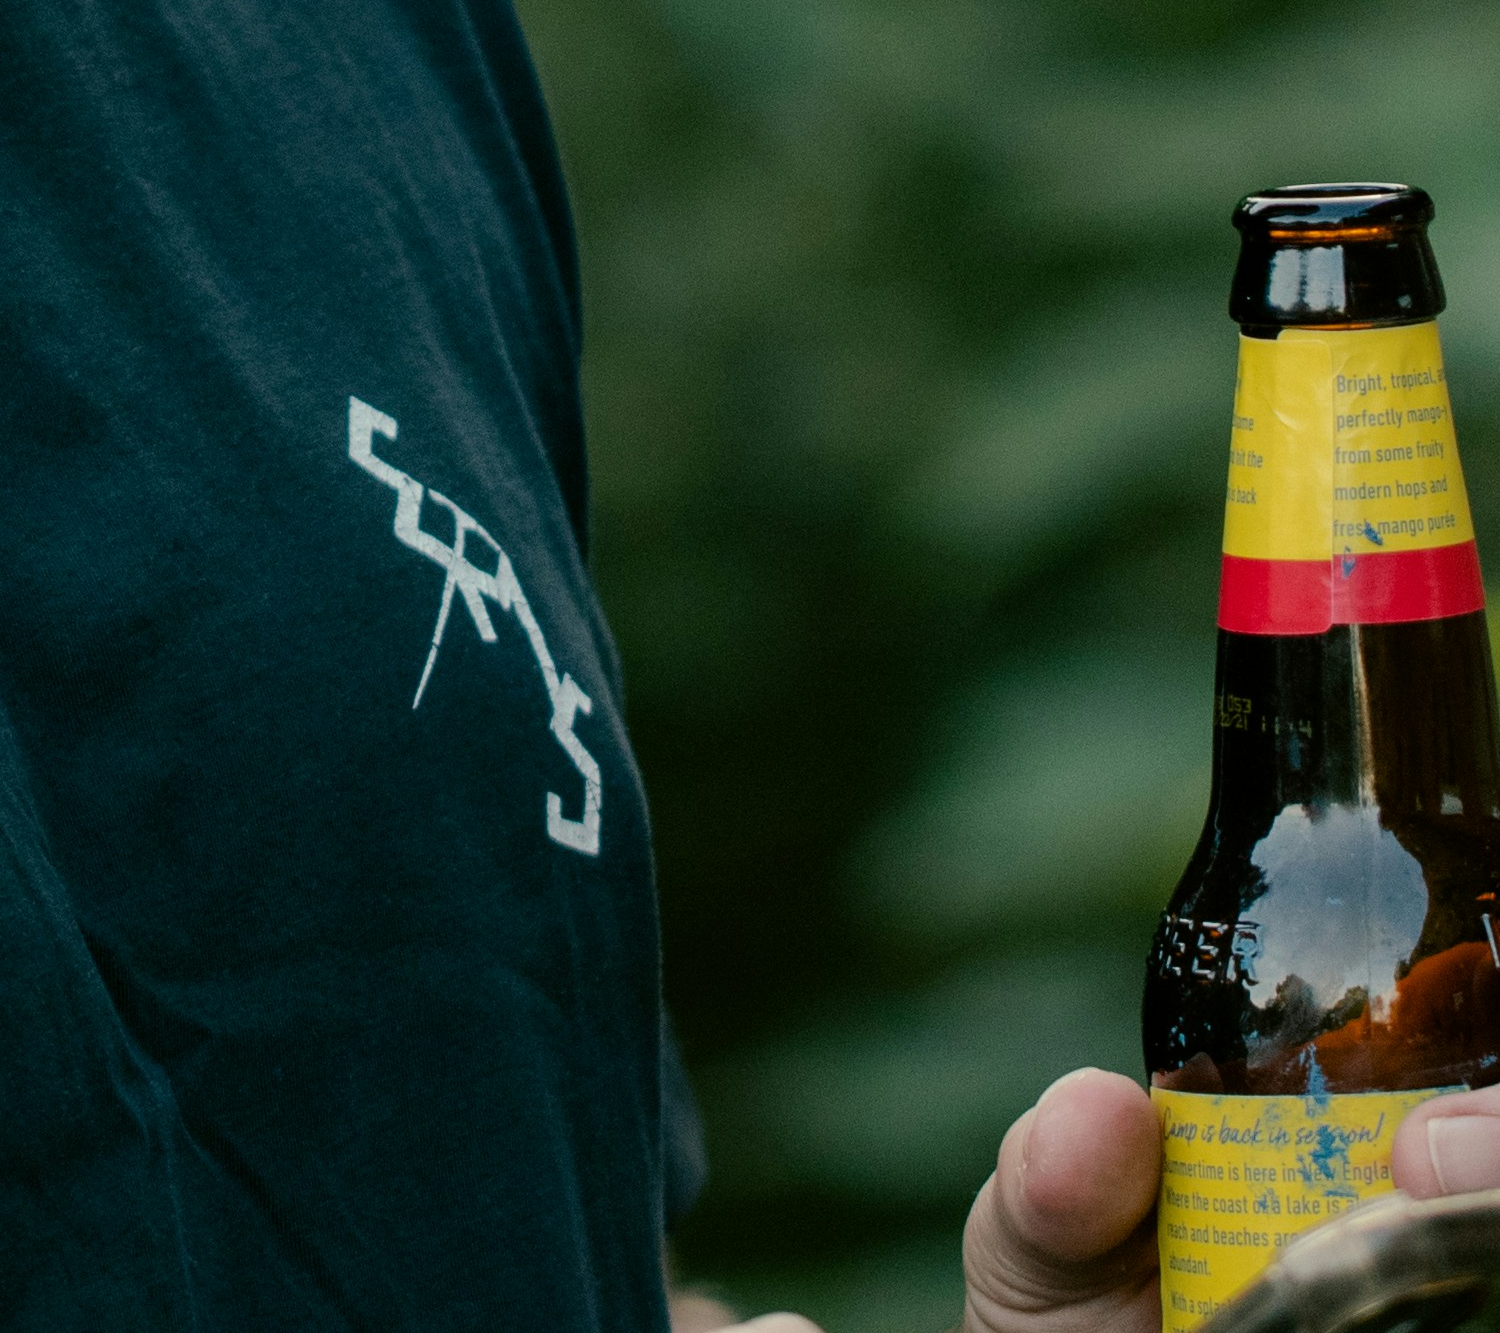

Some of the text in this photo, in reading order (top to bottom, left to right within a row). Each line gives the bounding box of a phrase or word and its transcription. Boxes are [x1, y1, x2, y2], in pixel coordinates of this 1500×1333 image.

[1336, 373, 1388, 395] Bright,
[1390, 367, 1437, 391] tropical,
[1336, 408, 1403, 432] perfectly
[1247, 451, 1263, 468] the
[1335, 439, 1444, 464] from some fruity
[1236, 486, 1257, 504] back
[1335, 475, 1448, 500] modern hops and
[1333, 511, 1456, 537] fres mango purée
[1163, 1106, 1198, 1146] Camp
[1201, 1122, 1216, 1143] is
[1218, 1114, 1263, 1145] back
[1268, 1126, 1291, 1145] in
[1228, 1161, 1240, 1181] is
[1243, 1163, 1277, 1182] here
[1282, 1162, 1296, 1182] in
[1343, 1161, 1393, 1185] Engla
[1192, 1192, 1209, 1211] the
[1213, 1196, 1249, 1214] coast
[1272, 1199, 1282, 1215] a
[1287, 1196, 1321, 1215] lake
[1326, 1194, 1340, 1214] is
[1166, 1221, 1188, 1241] reach
[1190, 1225, 1209, 1244] and
[1213, 1227, 1269, 1247] beaches
[1169, 1254, 1212, 1276] abundant.
